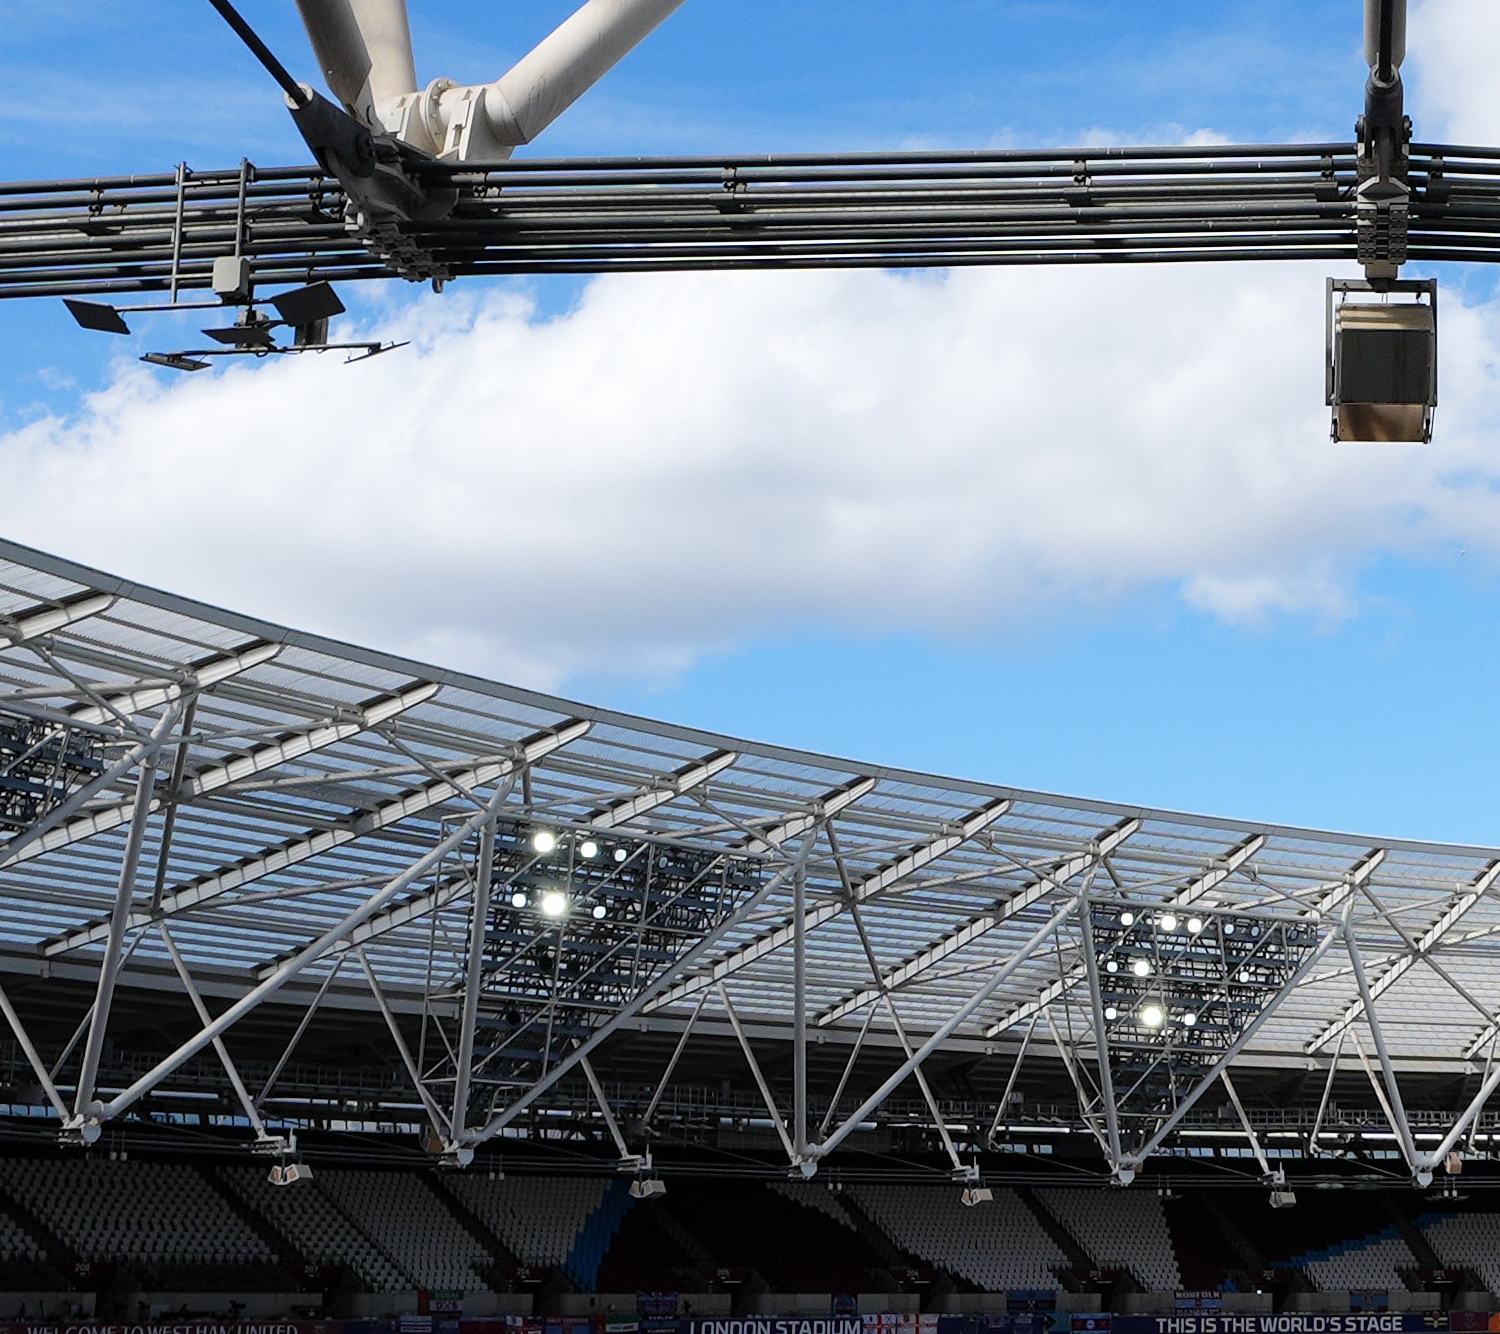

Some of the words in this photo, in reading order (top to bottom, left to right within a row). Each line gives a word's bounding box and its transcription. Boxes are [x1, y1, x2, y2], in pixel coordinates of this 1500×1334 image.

[1155, 1317, 1196, 1333] THIS
[1200, 1317, 1217, 1333] IS
[1220, 1317, 1255, 1333] THE
[1260, 1315, 1342, 1333] WORLD'S
[1344, 1315, 1403, 1332] STAGE
